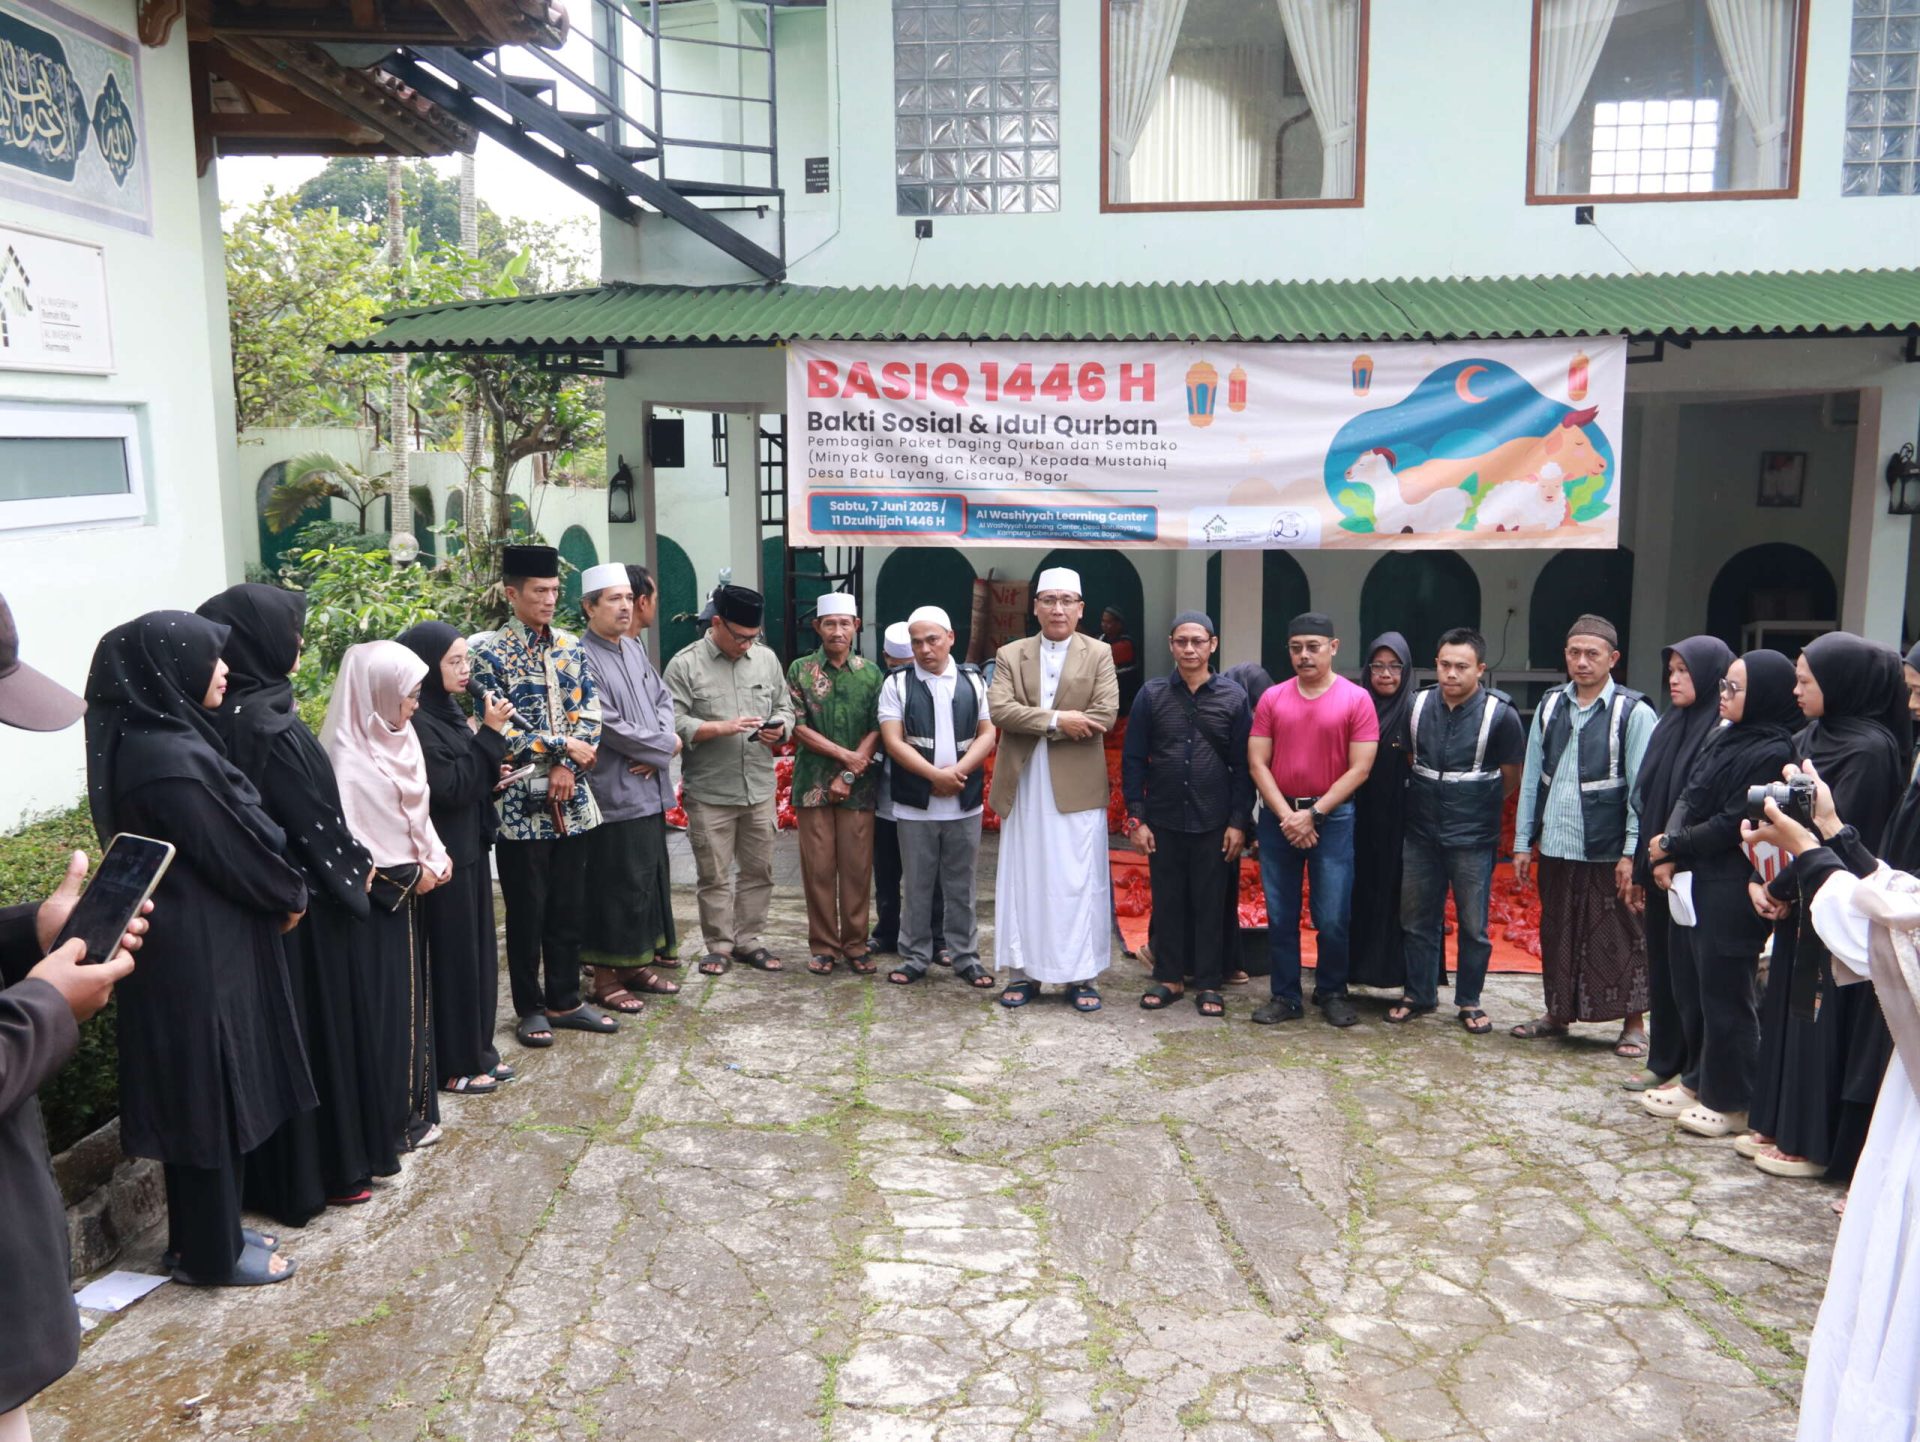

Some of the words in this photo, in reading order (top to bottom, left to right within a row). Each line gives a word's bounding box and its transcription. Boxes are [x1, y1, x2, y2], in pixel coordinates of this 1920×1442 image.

[807, 360, 970, 406] BASIQ
[980, 361, 1106, 402] 1446
[1119, 363, 1155, 402] H
[807, 410, 875, 432] Bakti
[882, 411, 962, 433] Sosial
[969, 414, 988, 434] &
[996, 414, 1046, 435] Idul
[1053, 414, 1157, 438] Qurban
[808, 436, 894, 450] Pembagian
[900, 437, 942, 449] Paket
[947, 438, 1001, 452] Daging
[1007, 438, 1065, 451] Qurban
[1070, 440, 1099, 451] dan
[1106, 439, 1177, 452] Sembako
[809, 449, 868, 465] (Minyak
[874, 452, 929, 467] Goreng
[935, 453, 964, 465] dan
[969, 452, 1024, 469] Kecap)
[1031, 455, 1089, 469] Kepada
[1095, 455, 1167, 470] Mustahiq
[808, 467, 844, 479] Desa
[850, 468, 884, 479] Batu
[890, 468, 949, 483] Layang,
[954, 469, 1019, 483] Cisarua,
[1025, 471, 1069, 485] Bogor
[829, 500, 869, 514] Sabtu,
[871, 501, 879, 512] 7
[880, 500, 907, 512] Juni
[910, 501, 939, 512] 2025
[831, 515, 840, 525] 11
[842, 515, 903, 529] Dzulhijjah
[905, 515, 934, 526] 1446
[936, 516, 945, 526] H
[976, 509, 987, 519] Al
[989, 509, 1053, 522] Washiyyah
[1056, 510, 1107, 523] Learning
[1109, 511, 1148, 522] Center
